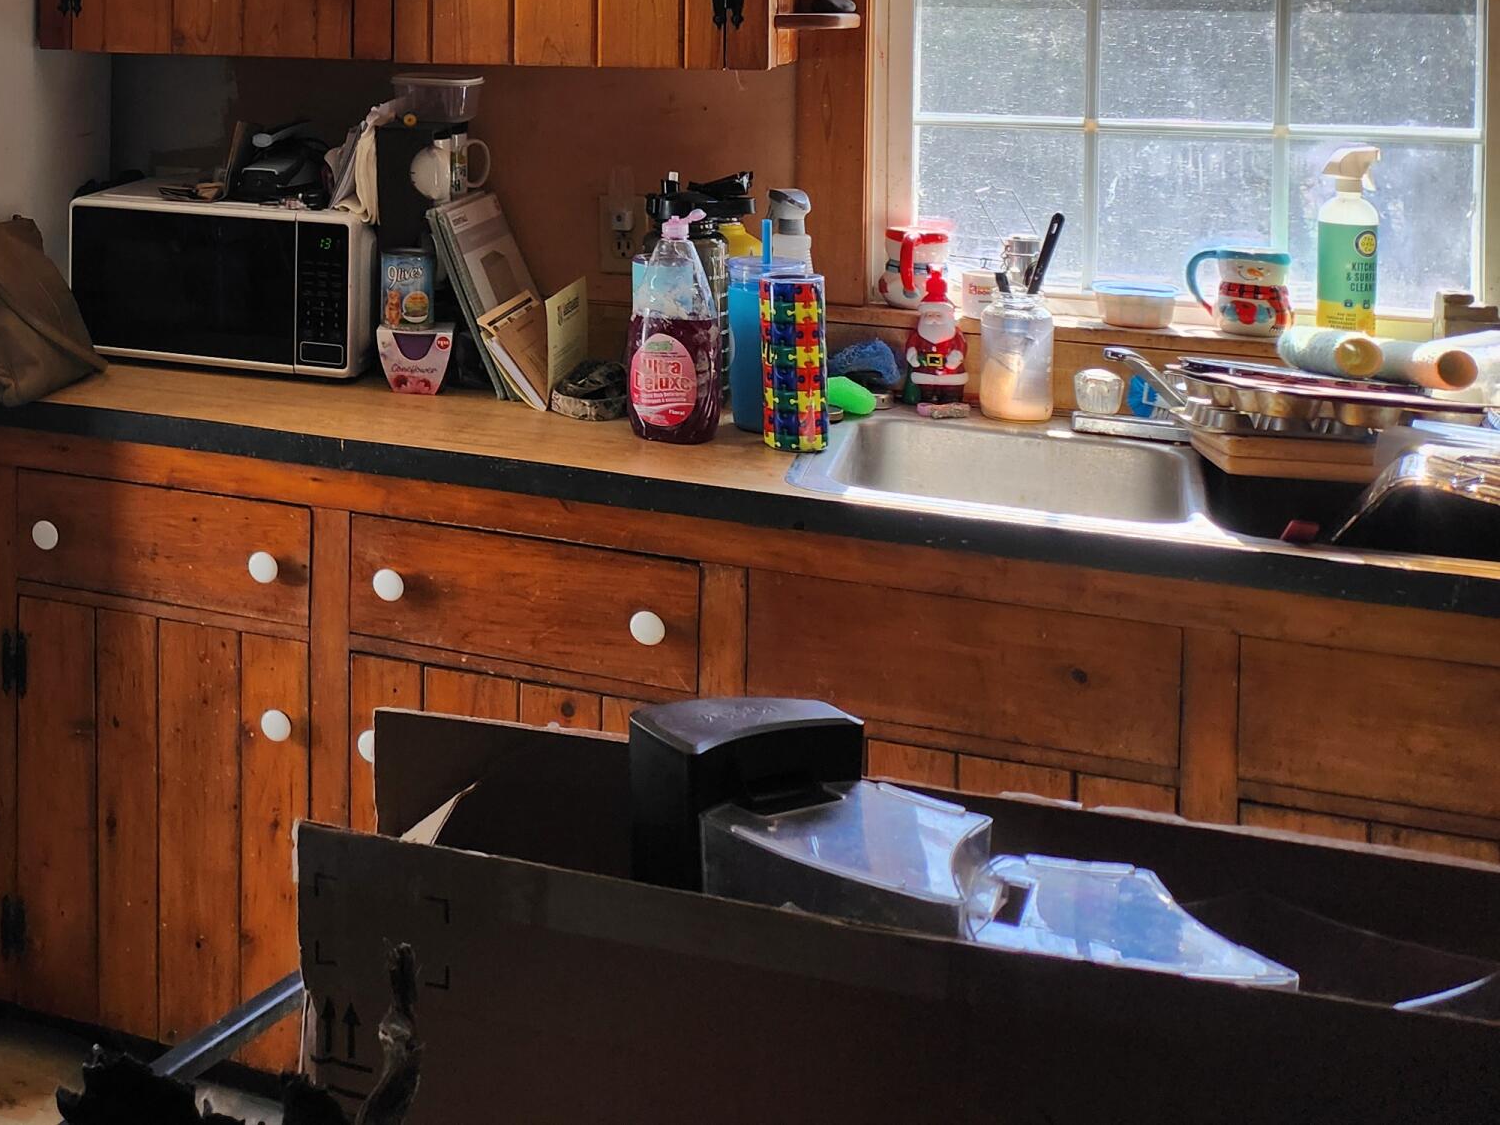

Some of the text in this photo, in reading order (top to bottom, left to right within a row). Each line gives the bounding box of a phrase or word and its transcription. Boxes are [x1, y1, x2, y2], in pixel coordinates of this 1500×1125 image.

[1346, 273, 1351, 281] &
[1350, 283, 1374, 292] CLEAN
[636, 371, 691, 391] Deluxe
